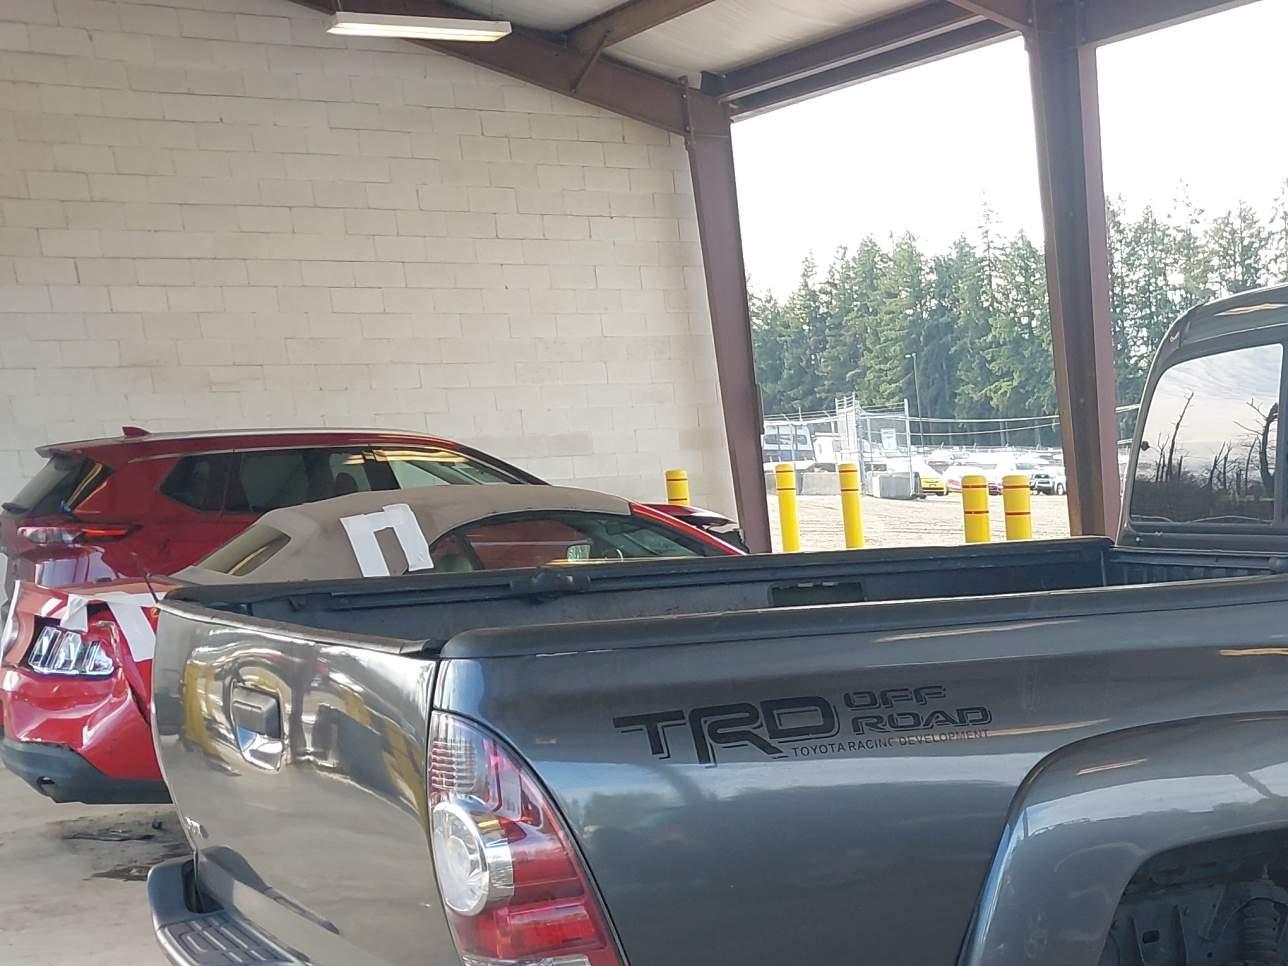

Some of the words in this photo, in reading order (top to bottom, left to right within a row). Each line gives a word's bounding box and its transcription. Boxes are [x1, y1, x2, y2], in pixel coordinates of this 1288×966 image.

[843, 685, 947, 711] OFF
[613, 696, 840, 769] TRD
[851, 706, 993, 736] ROAD
[791, 742, 845, 757] TOYOTA
[898, 728, 990, 747] DEVELOPMENT
